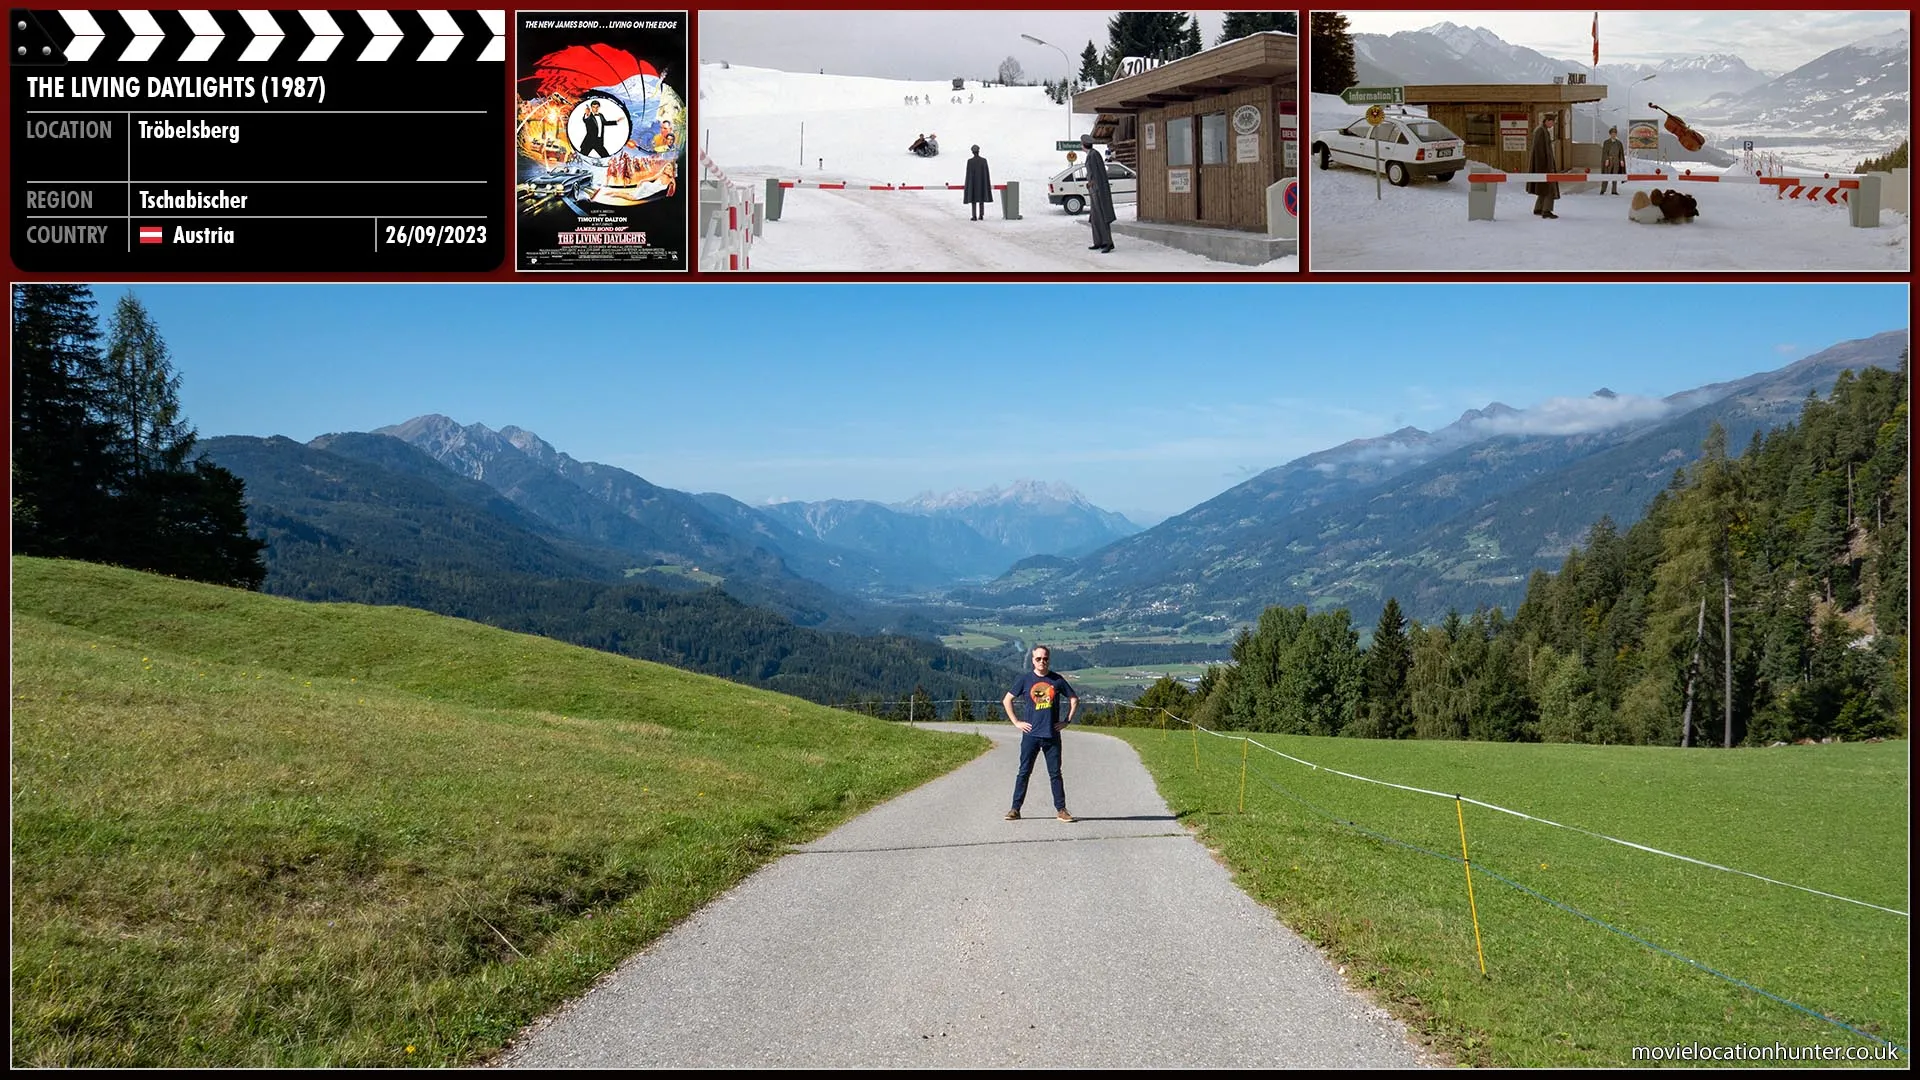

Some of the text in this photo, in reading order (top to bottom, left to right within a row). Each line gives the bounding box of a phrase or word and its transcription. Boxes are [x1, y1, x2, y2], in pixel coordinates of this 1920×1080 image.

[609, 21, 632, 29] LIVING
[633, 21, 645, 29] ON
[645, 21, 658, 29] THE
[658, 21, 677, 29] EDGE
[557, 232, 646, 245] THE LIVING DAYLIGHTS
